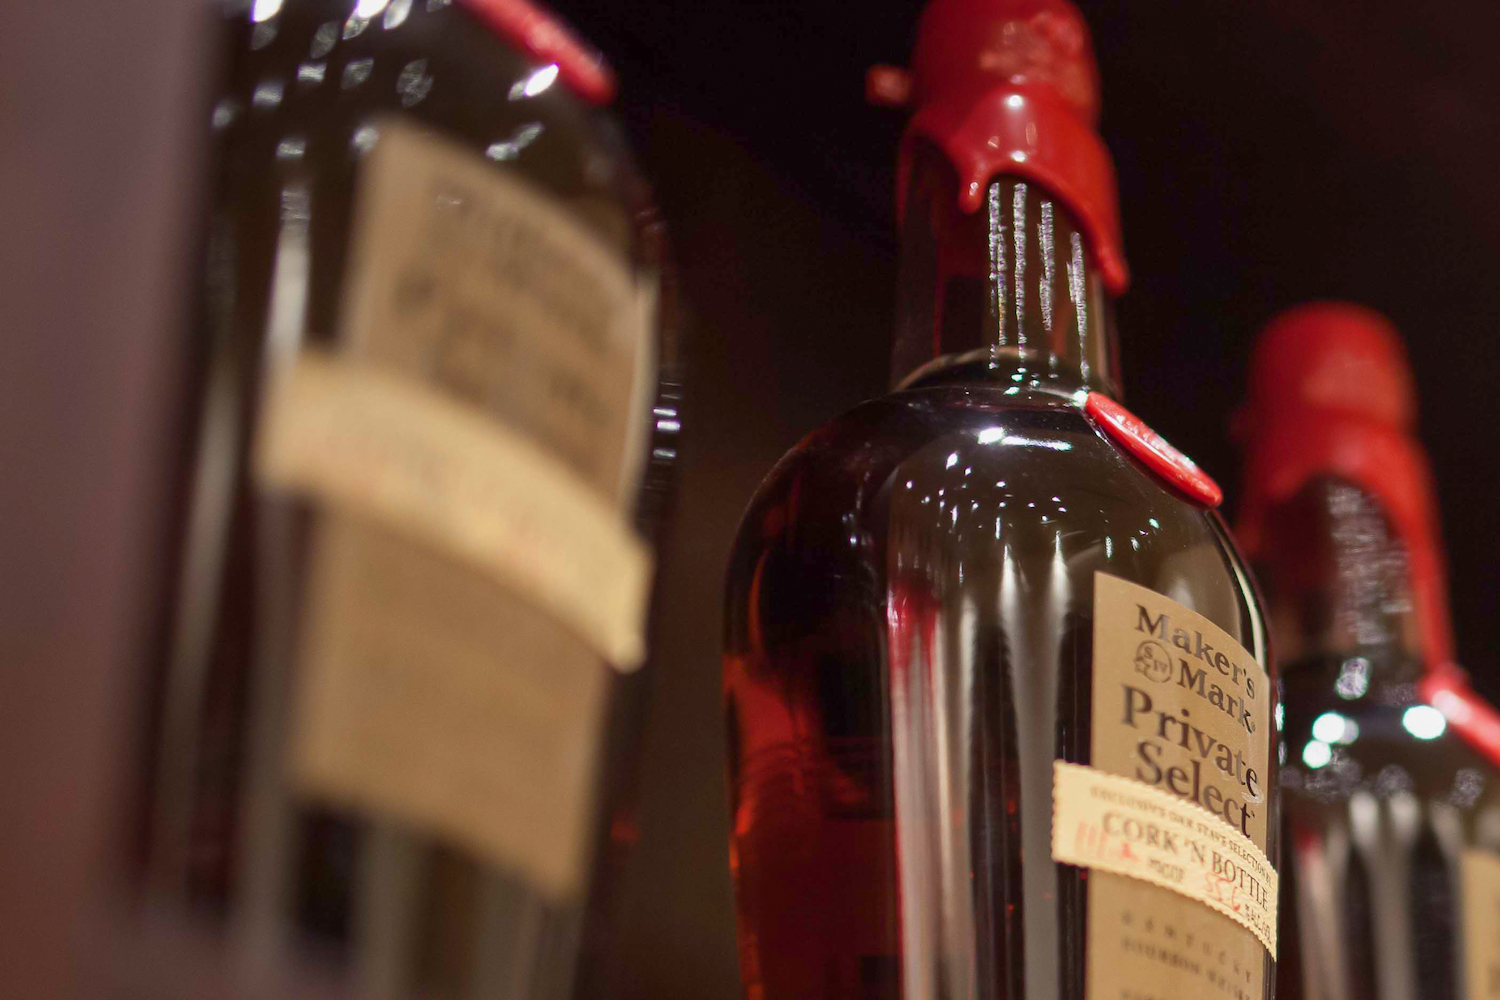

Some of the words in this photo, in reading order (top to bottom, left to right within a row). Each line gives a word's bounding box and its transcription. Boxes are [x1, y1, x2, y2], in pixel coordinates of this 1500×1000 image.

[1135, 604, 1256, 700] Maker's
[1120, 682, 1258, 798] Private
[1136, 739, 1254, 838] Select
[1101, 810, 1180, 856] CORK
[1212, 850, 1268, 912] BOTTLE
[1229, 839, 1266, 877] SELECTION
